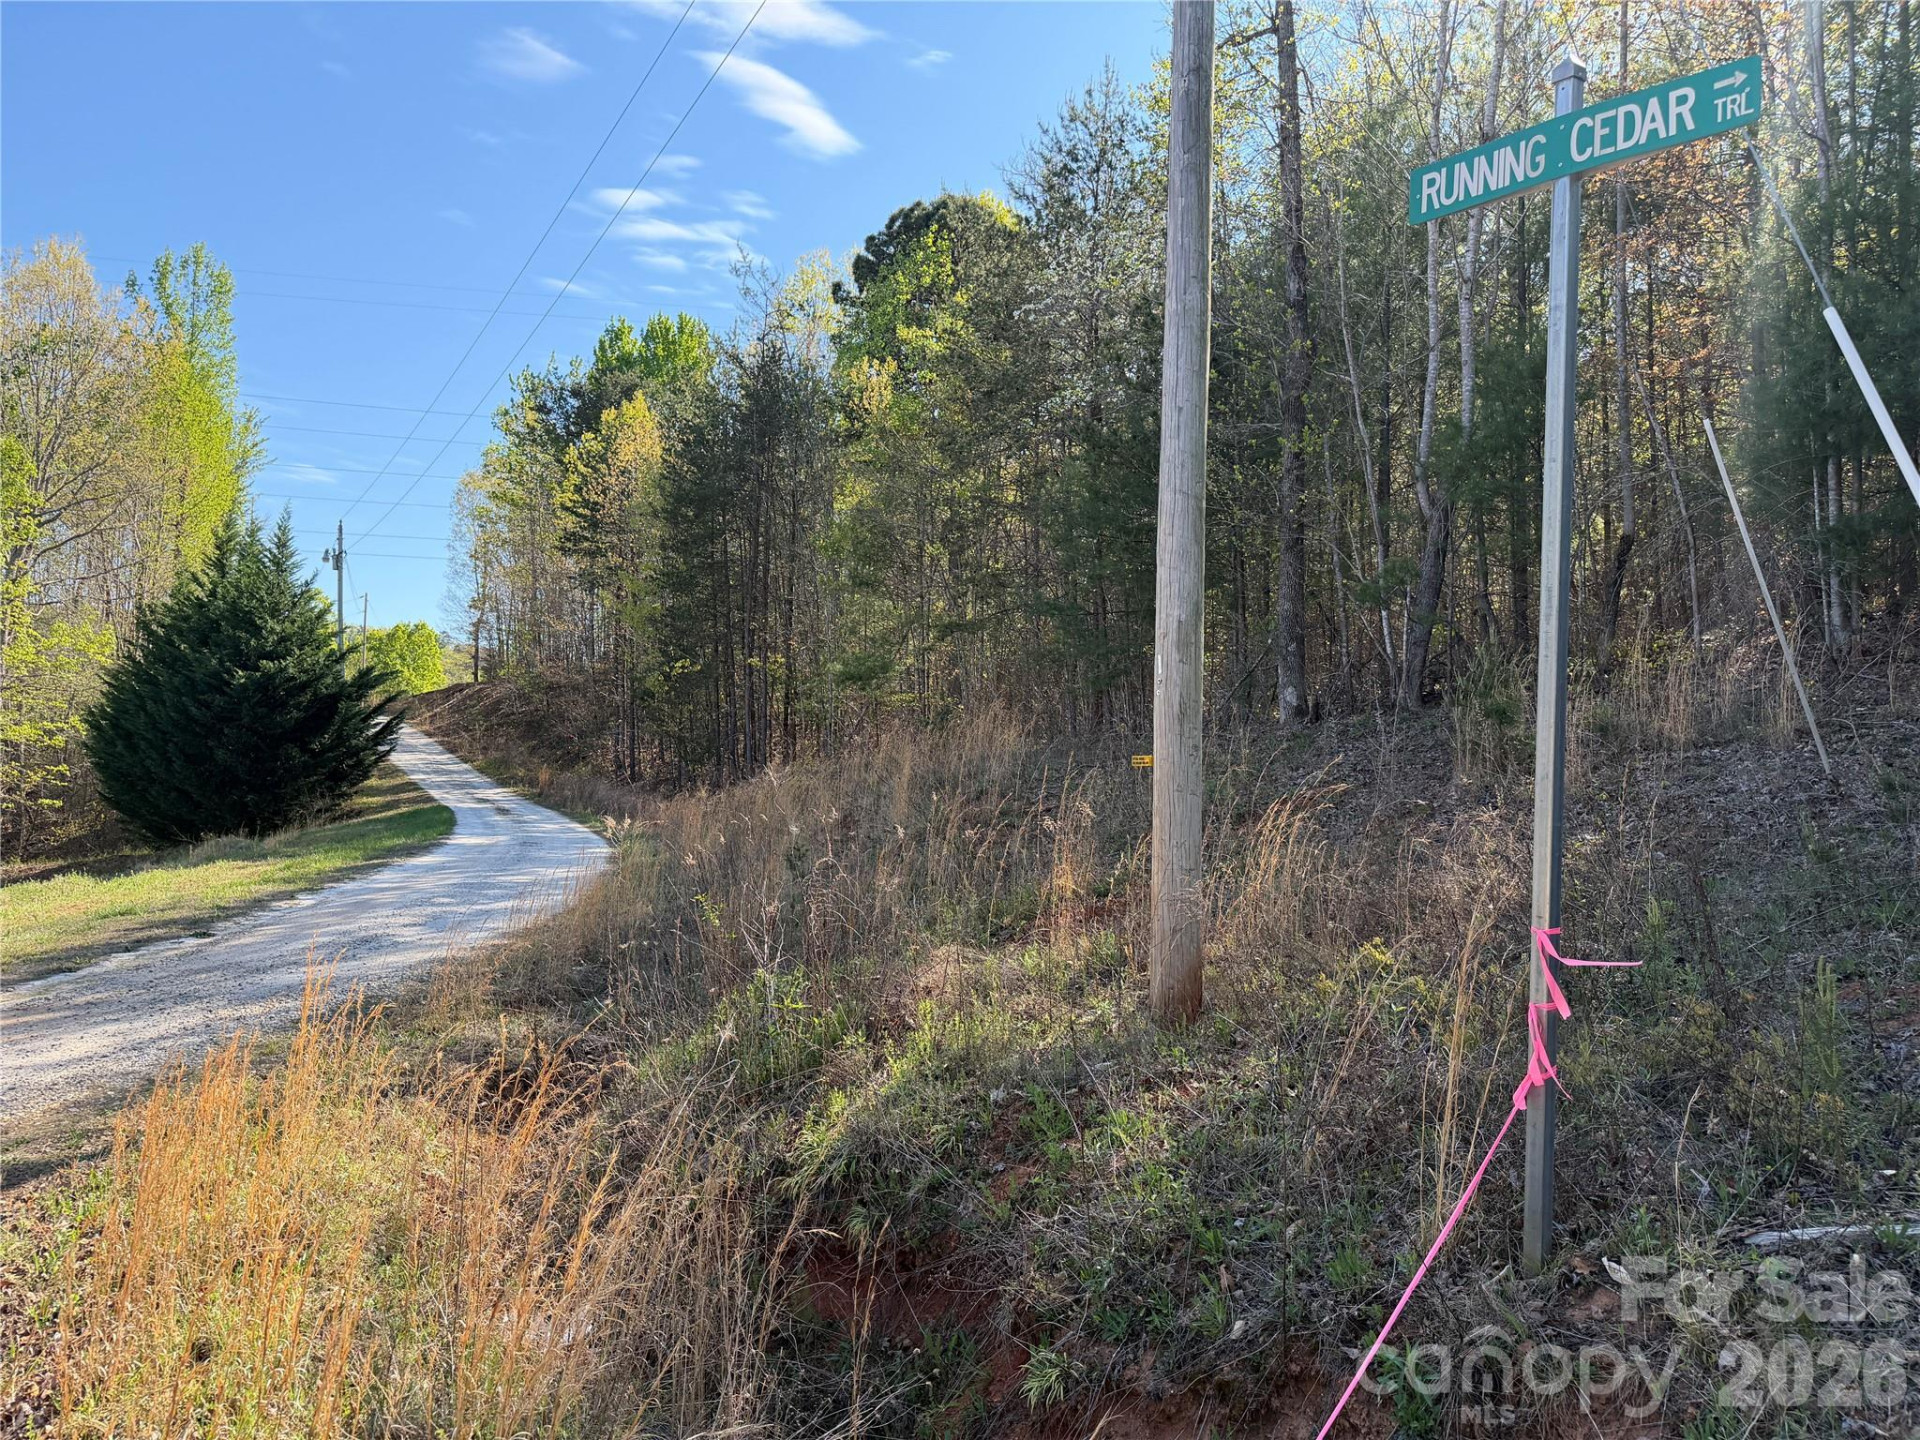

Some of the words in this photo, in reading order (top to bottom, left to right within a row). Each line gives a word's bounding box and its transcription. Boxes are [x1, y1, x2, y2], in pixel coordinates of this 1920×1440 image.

[1420, 135, 1546, 213] RUNNING
[1570, 87, 1695, 162] CEDAR
[1714, 89, 1755, 123] TRL
